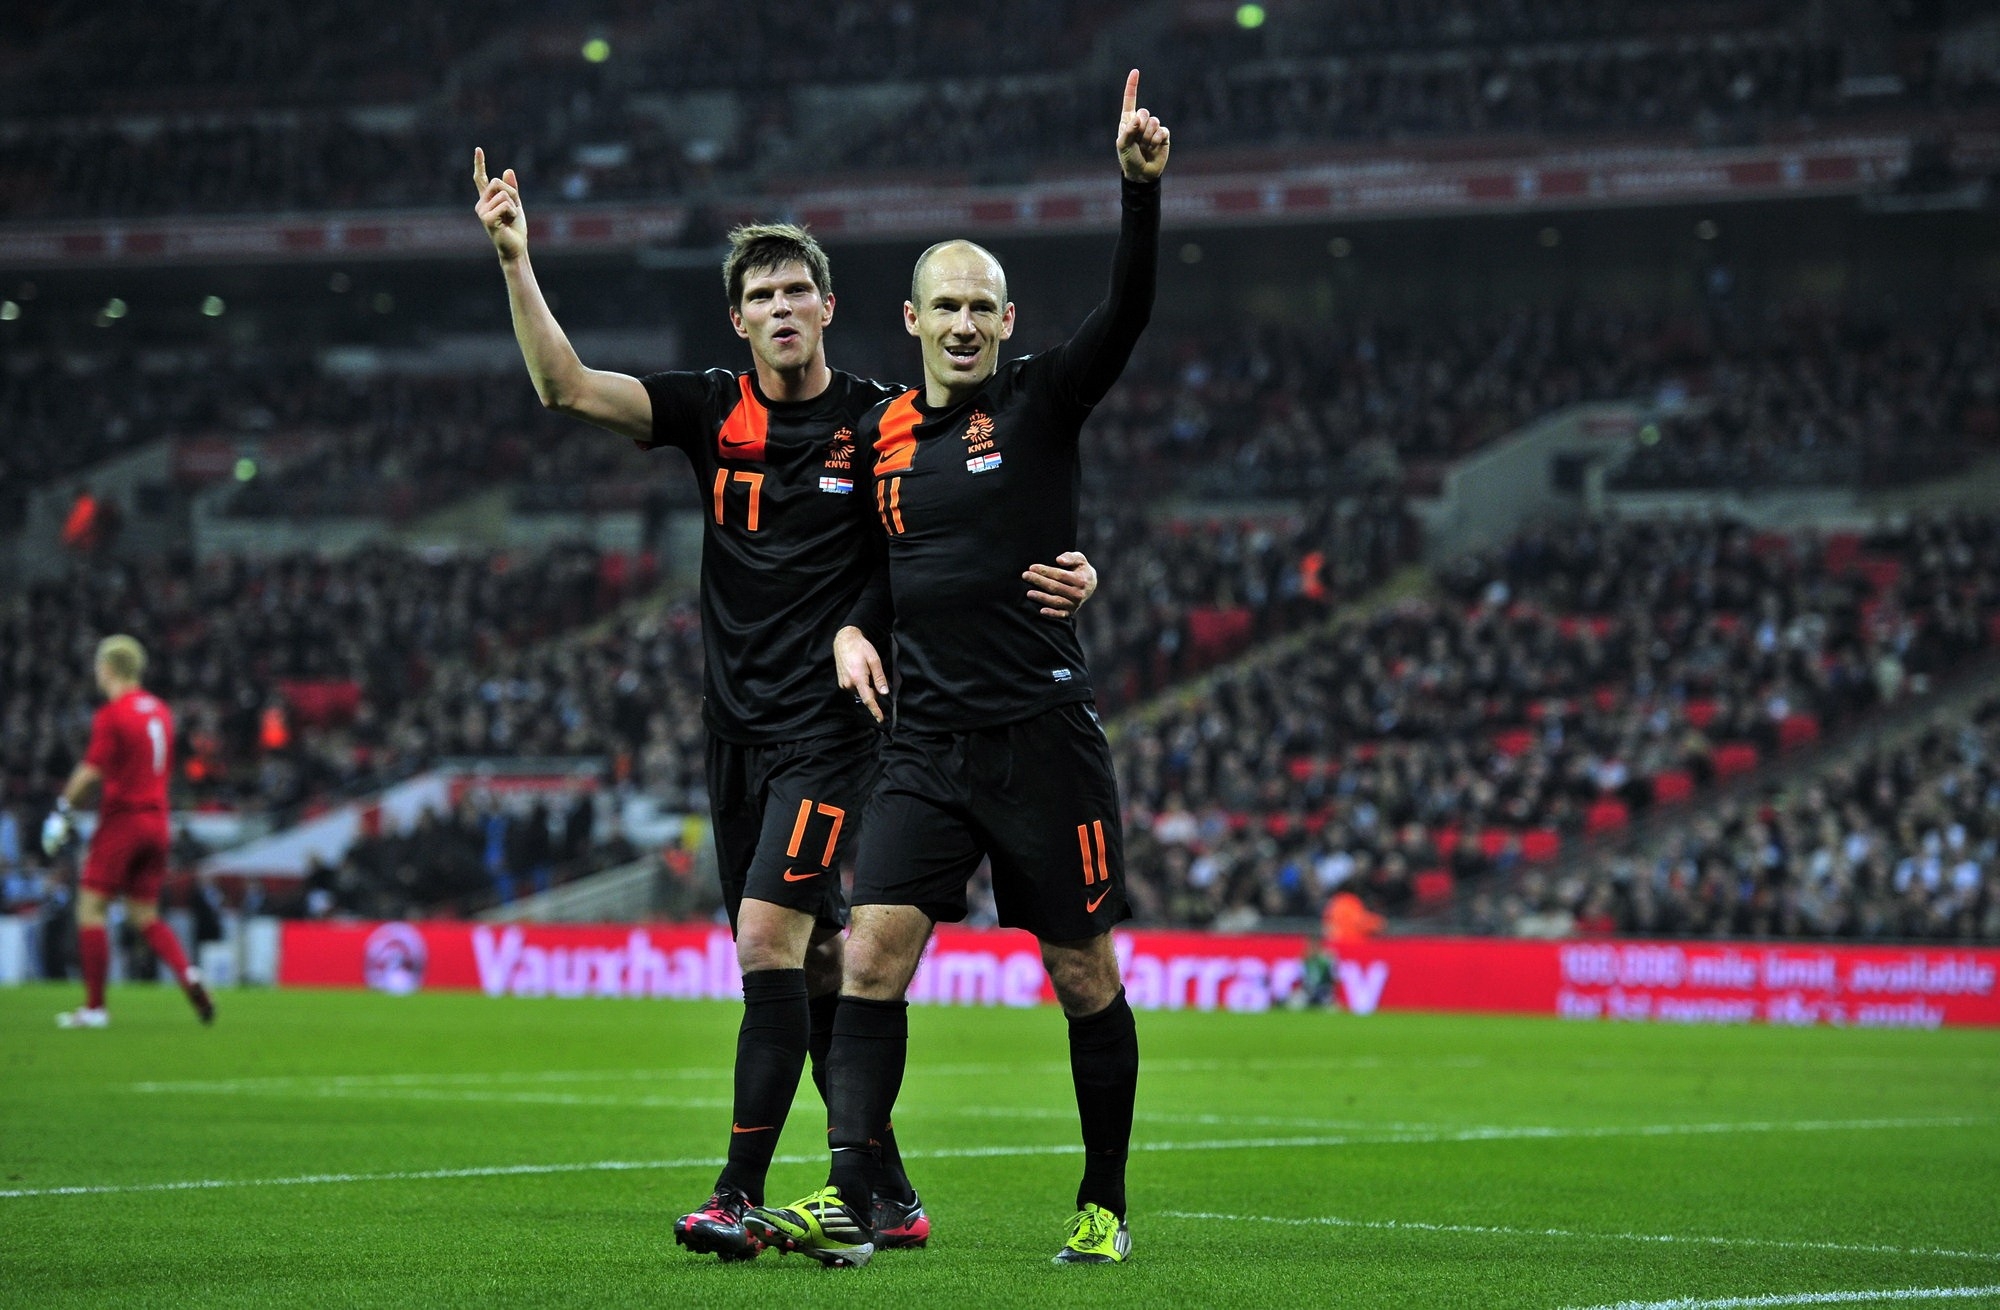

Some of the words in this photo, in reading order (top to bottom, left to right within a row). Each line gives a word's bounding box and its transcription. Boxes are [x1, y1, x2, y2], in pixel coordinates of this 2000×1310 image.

[824, 460, 851, 470] KNVB
[967, 440, 994, 454] KNVB
[713, 468, 765, 531] 17
[876, 476, 905, 536] 11
[147, 716, 168, 776] 1
[786, 798, 845, 868] 17
[1077, 819, 1109, 885] 11
[1688, 948, 1756, 990] mile
[1851, 952, 1996, 996] available
